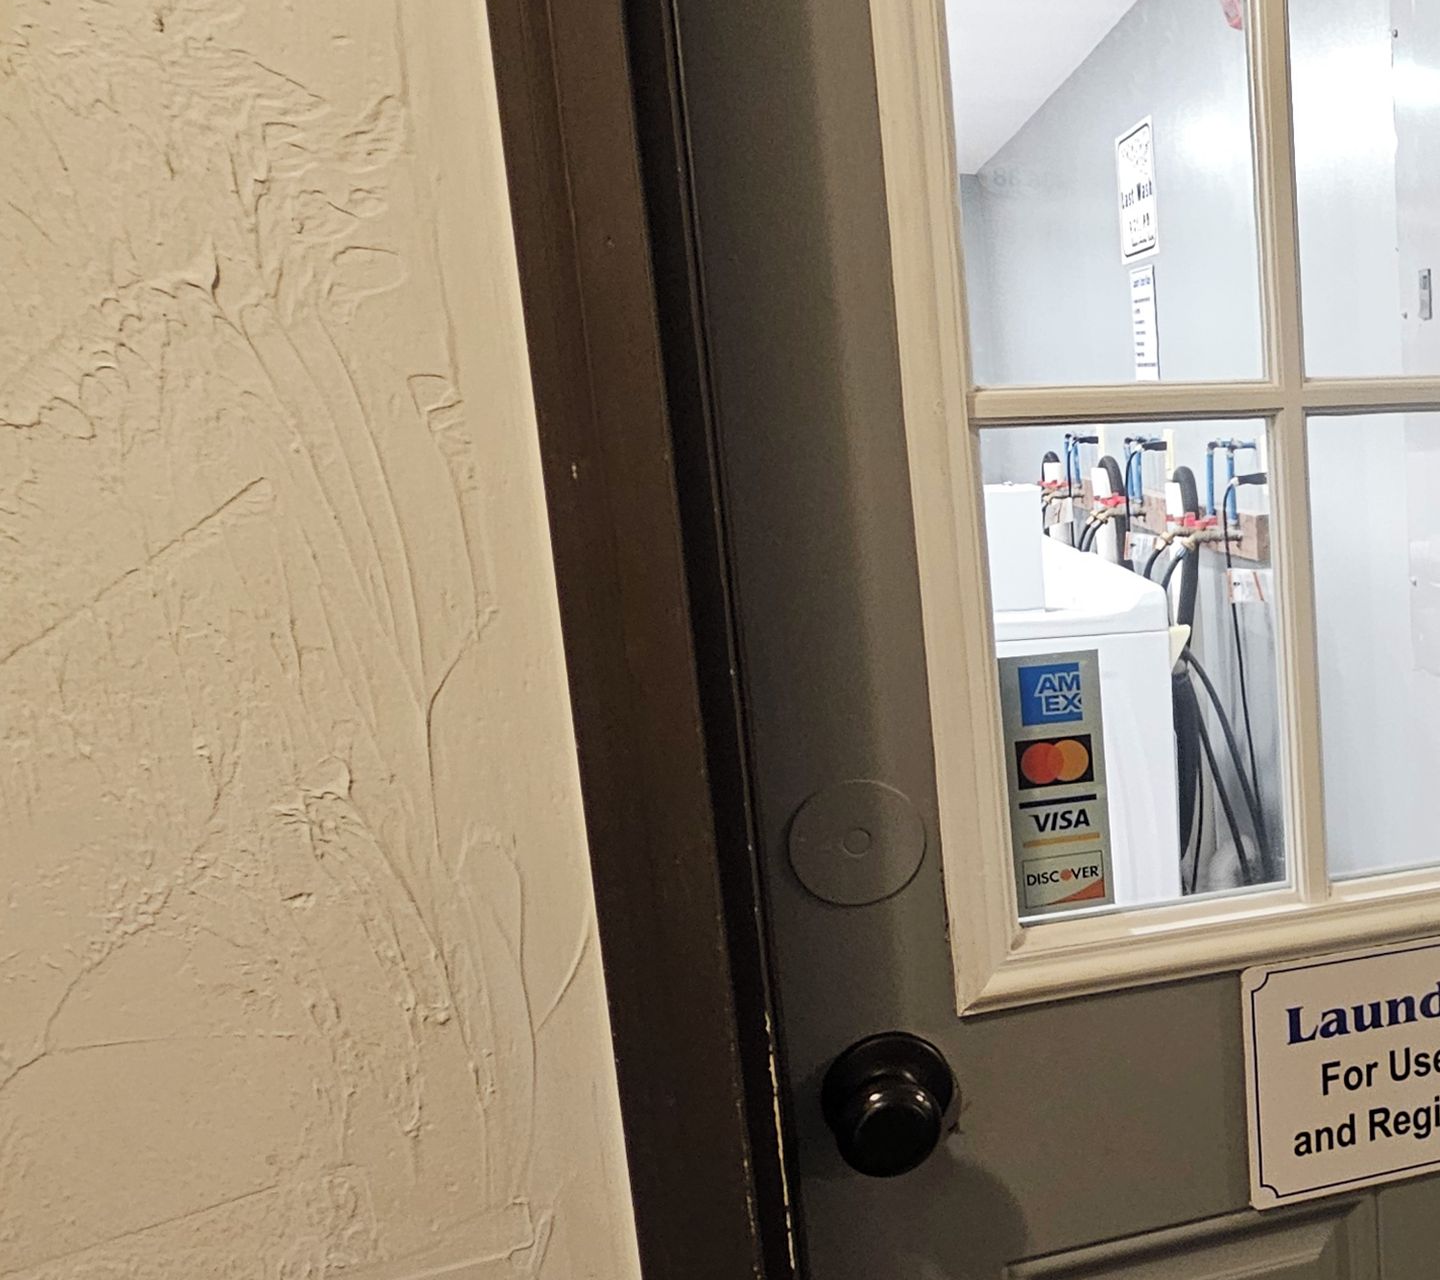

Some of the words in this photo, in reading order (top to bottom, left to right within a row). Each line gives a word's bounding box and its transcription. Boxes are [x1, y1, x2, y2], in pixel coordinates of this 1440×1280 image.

[1029, 809, 1090, 833] VISA
[1027, 865, 1099, 887] DISCOVER
[1321, 1060, 1379, 1096] For
[1294, 1114, 1357, 1157] and
